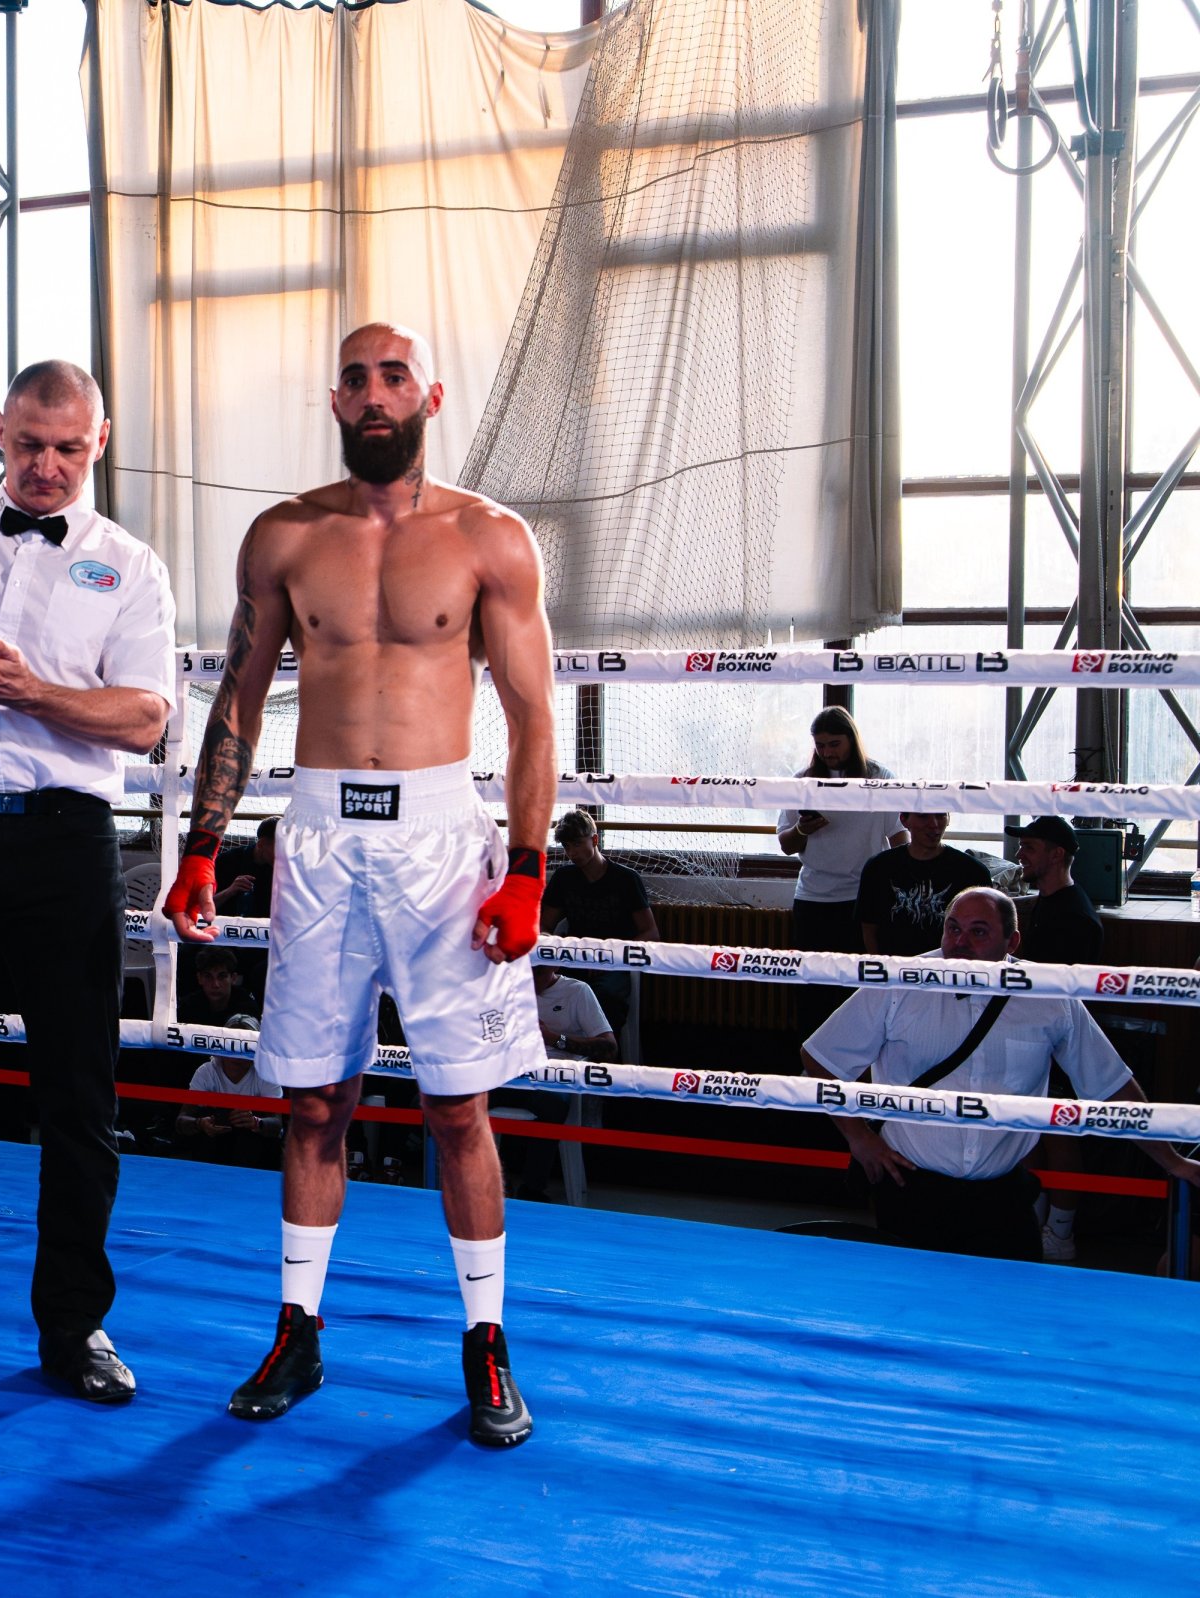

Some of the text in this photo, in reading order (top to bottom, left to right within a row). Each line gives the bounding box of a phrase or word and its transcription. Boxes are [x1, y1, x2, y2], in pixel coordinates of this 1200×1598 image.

[555, 656, 589, 672] IL
[715, 662, 772, 673] BOXING
[875, 654, 966, 672] BAIL
[1107, 662, 1174, 674] BOXING
[345, 788, 392, 803] PAFFEN
[345, 800, 392, 816] SPORT
[537, 946, 614, 965] BAIL
[742, 953, 802, 968] PATRON
[741, 966, 800, 977] BOXING
[900, 967, 989, 987] BAIL
[1134, 974, 1200, 990] PATRON
[1132, 986, 1198, 1000] BOXING
[704, 1073, 762, 1087] PATRON
[702, 1085, 757, 1098] BOXING
[857, 1092, 946, 1116] BAIL
[1086, 1105, 1154, 1119] PATRON
[1084, 1116, 1149, 1131] BOXING
